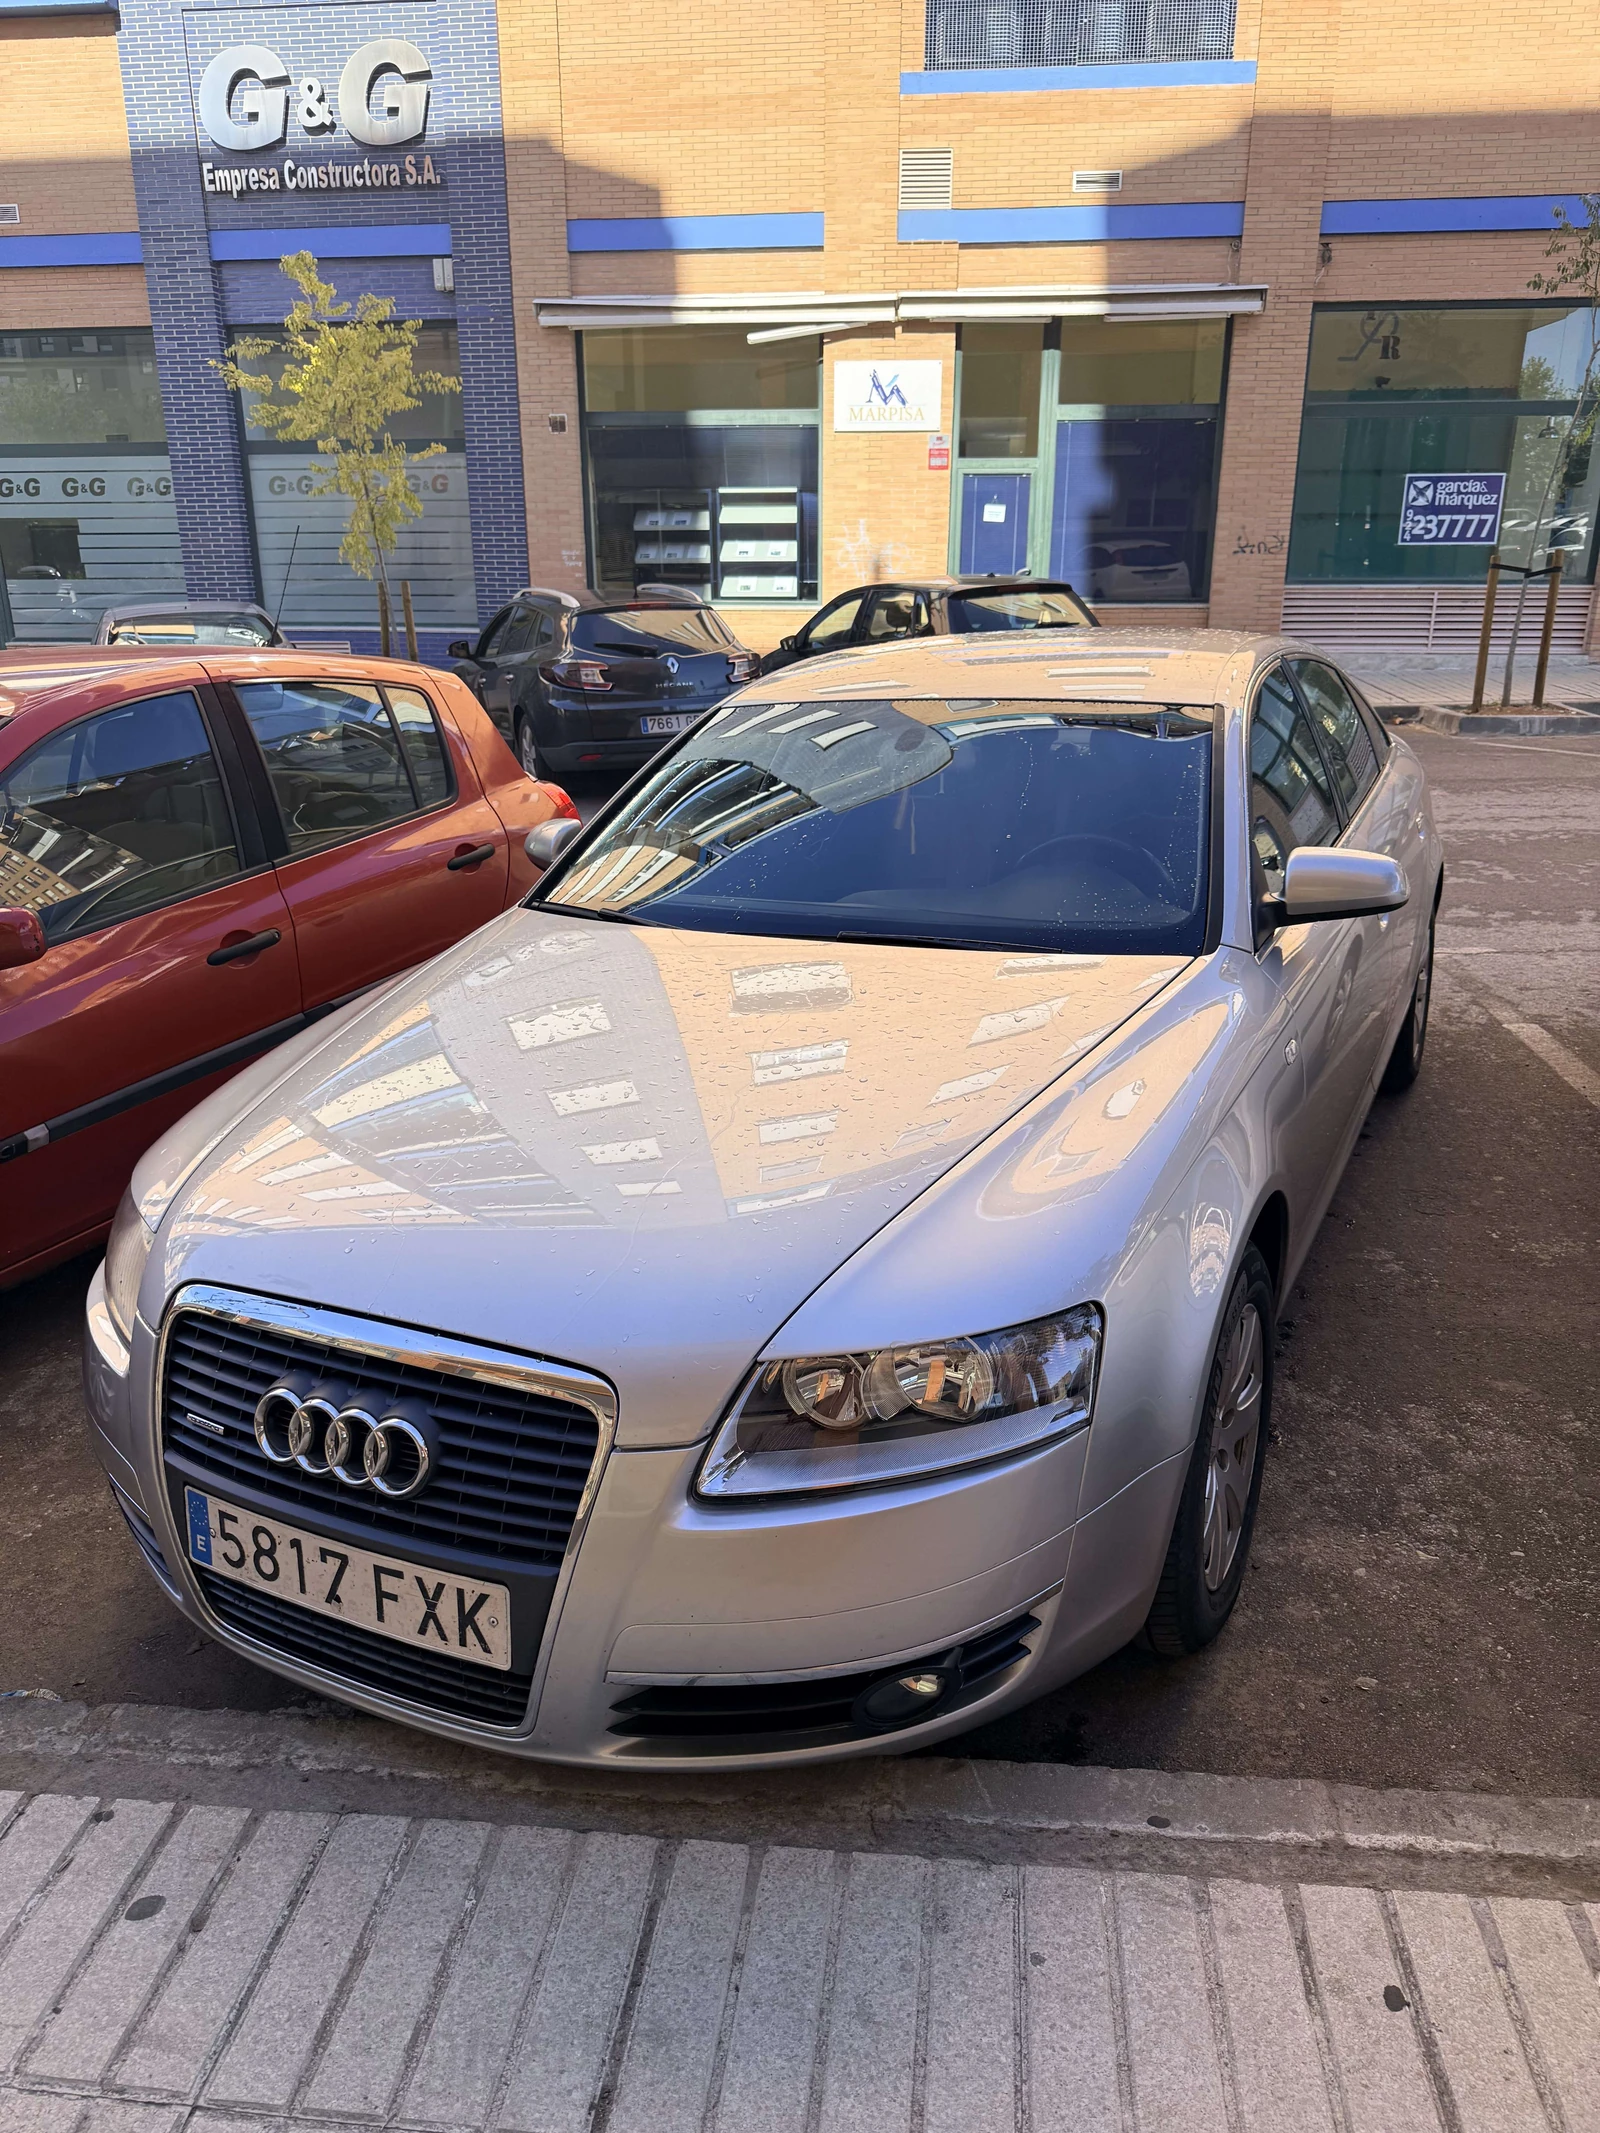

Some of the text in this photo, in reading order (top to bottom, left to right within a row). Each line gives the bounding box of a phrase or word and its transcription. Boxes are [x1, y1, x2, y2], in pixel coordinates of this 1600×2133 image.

[199, 39, 432, 151] G&G
[202, 154, 441, 198] Empresa Constructora S.A.
[848, 407, 925, 421] MARPISA
[0, 477, 41, 497] G&G
[61, 477, 106, 497] G&G
[127, 476, 171, 496] G&G
[268, 475, 314, 495] G&G
[1435, 493, 1498, 509] márquez
[1411, 515, 1495, 539] 237777
[649, 716, 681, 730] 7661
[196, 1534, 207, 1551] E
[218, 1509, 492, 1654] 5817 FXK
